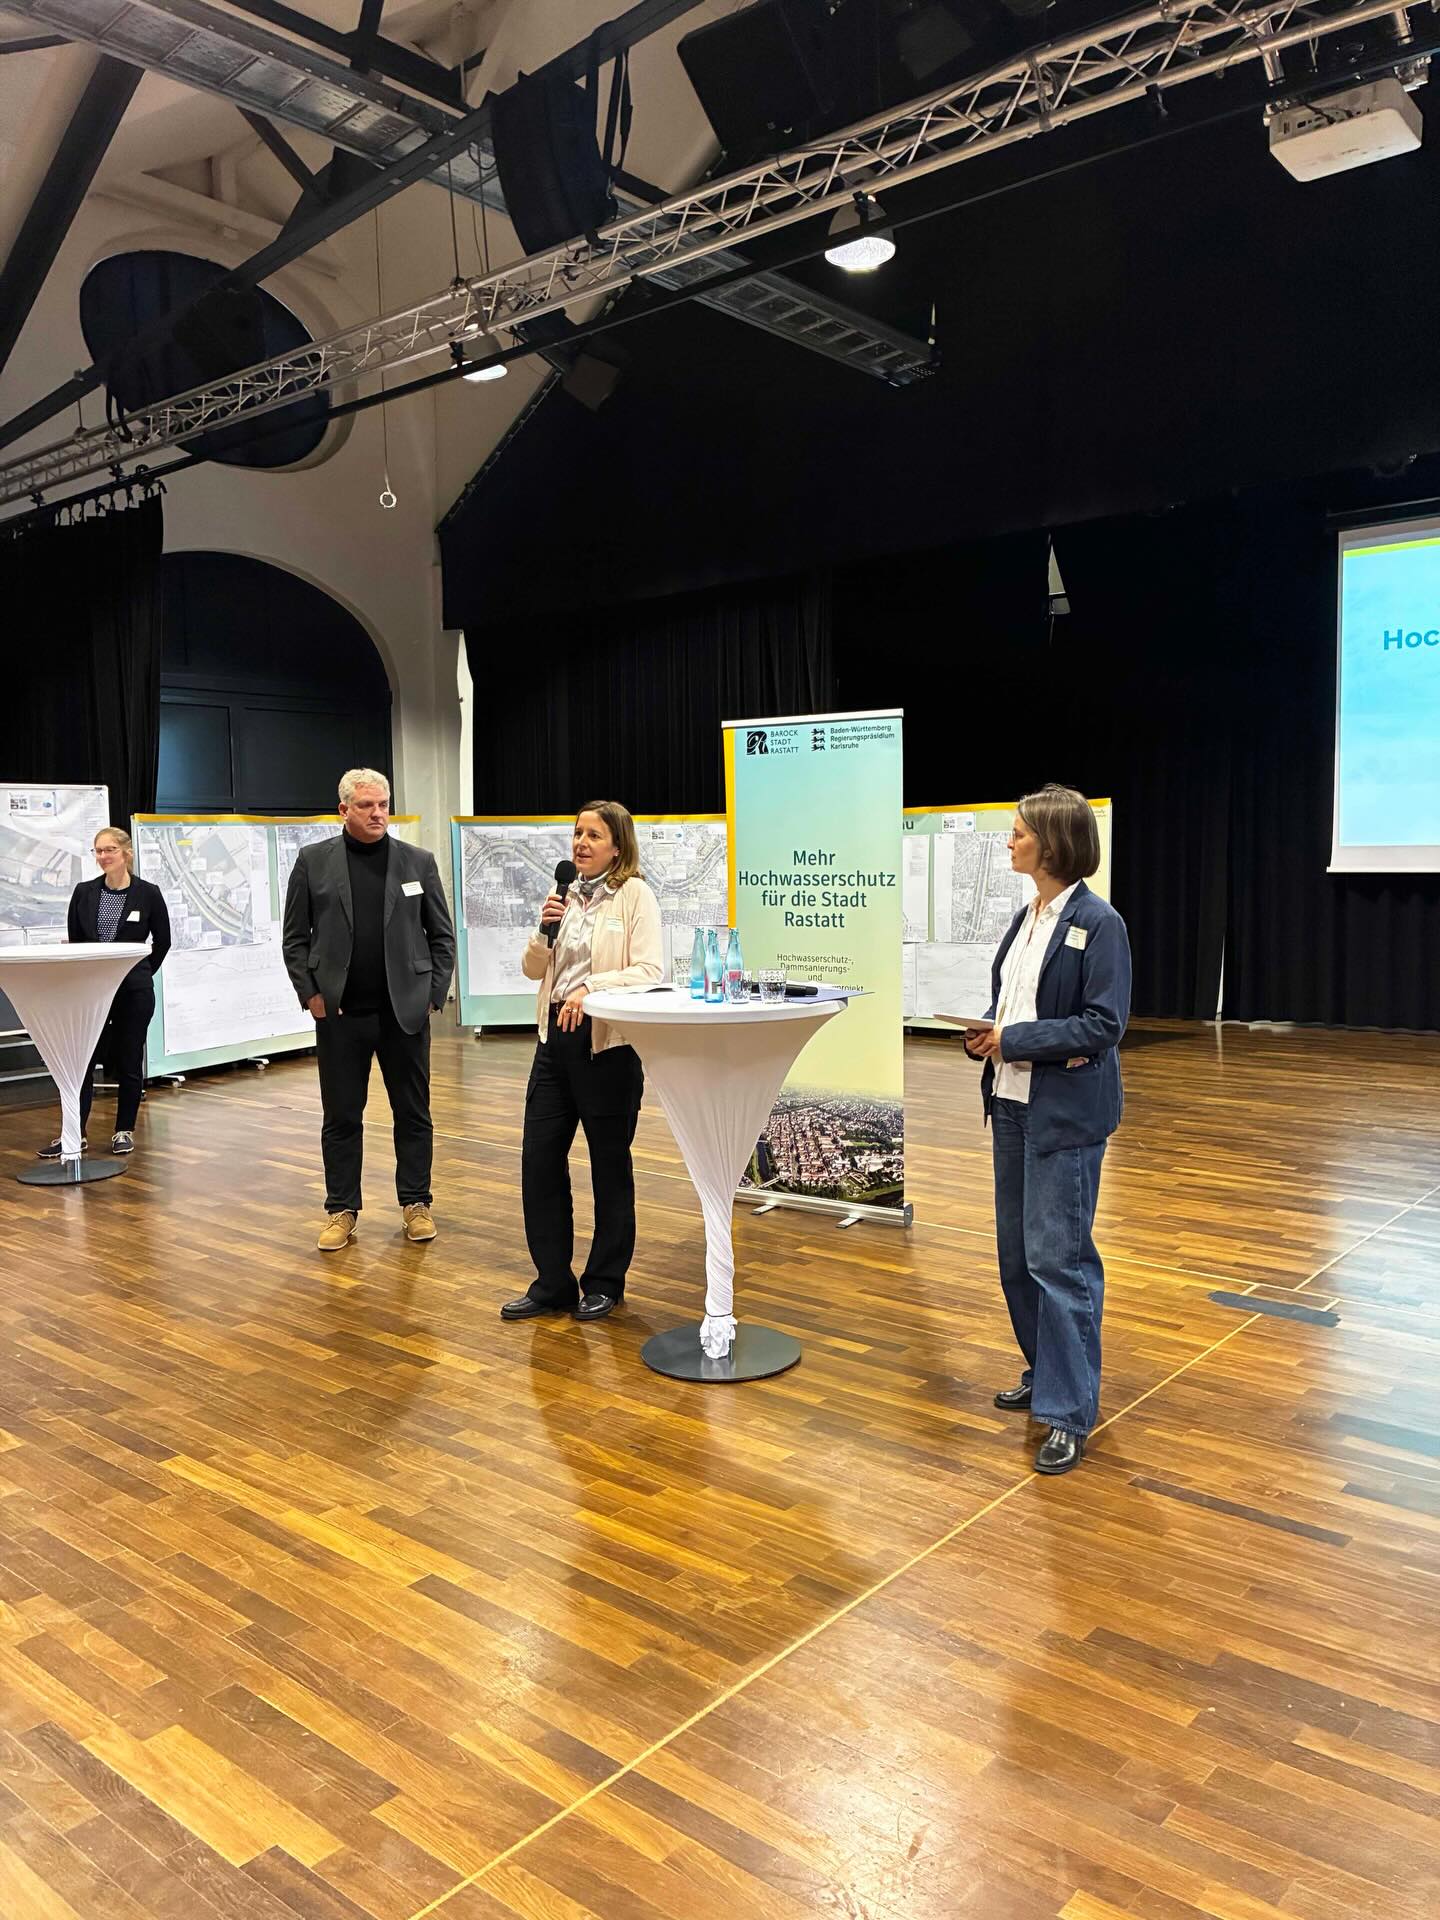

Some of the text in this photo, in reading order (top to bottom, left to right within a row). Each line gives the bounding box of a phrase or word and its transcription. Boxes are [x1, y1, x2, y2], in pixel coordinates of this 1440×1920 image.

[770, 729, 799, 738] BAROCK
[830, 725, 892, 735] Baden-Württemberg
[830, 732, 895, 743] Regierungspräsidium
[770, 746, 800, 755] RASTATT
[830, 742, 859, 750] Karlsruhe
[793, 849, 836, 866] Mehr
[738, 870, 896, 887] Hochwasserschutz
[761, 890, 867, 908] für die Stadt
[784, 911, 845, 928] Rastatt
[777, 953, 855, 965] Hochwasserschutz-,
[808, 974, 823, 982] und
